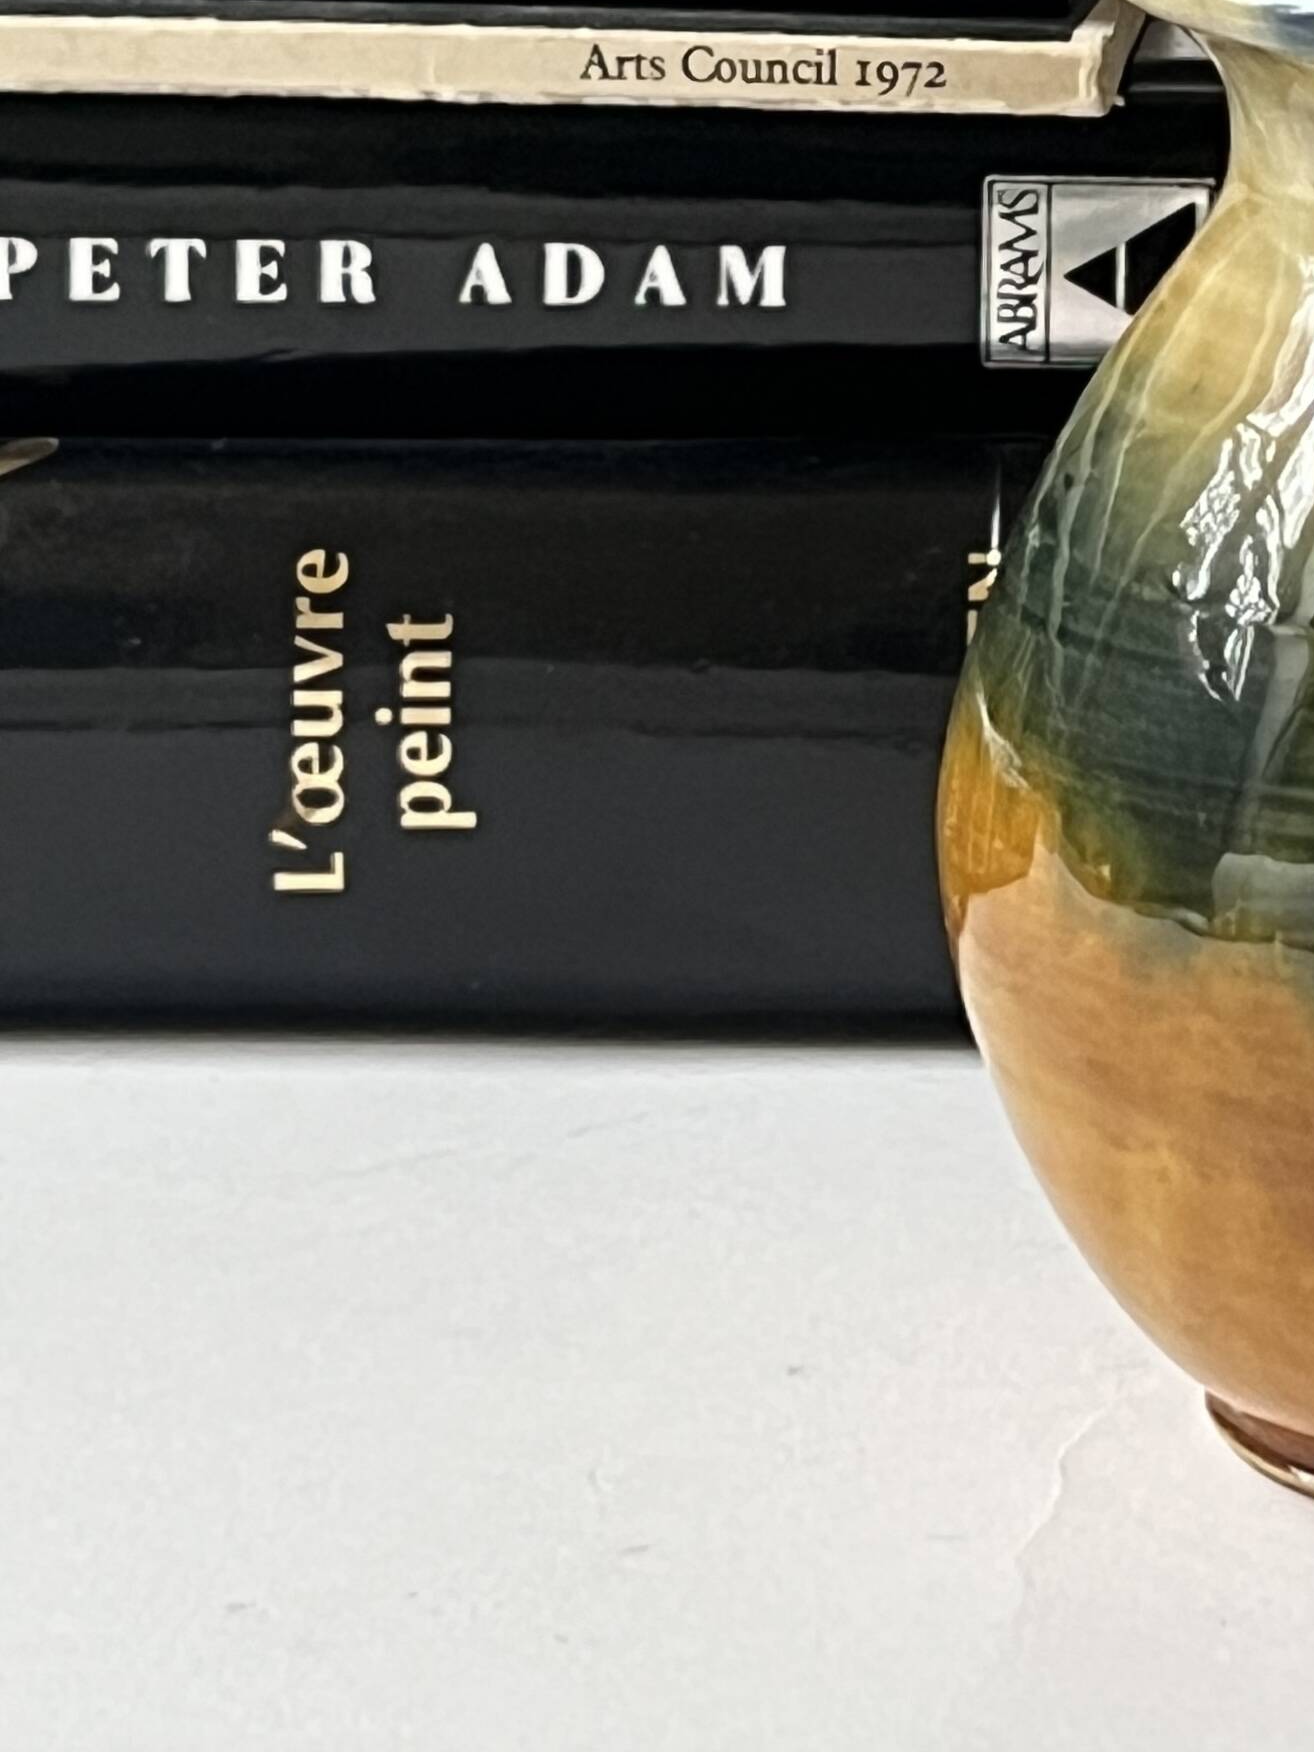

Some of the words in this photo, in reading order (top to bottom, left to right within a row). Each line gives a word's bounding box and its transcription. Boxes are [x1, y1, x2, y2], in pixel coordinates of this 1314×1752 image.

[580, 43, 667, 82] Arts
[681, 45, 839, 87] Council
[855, 60, 947, 97] 1972
[0, 236, 376, 304] PETER
[458, 242, 787, 307] ADAM
[997, 188, 1044, 354] ABRAMS
[374, 613, 478, 829] peint
